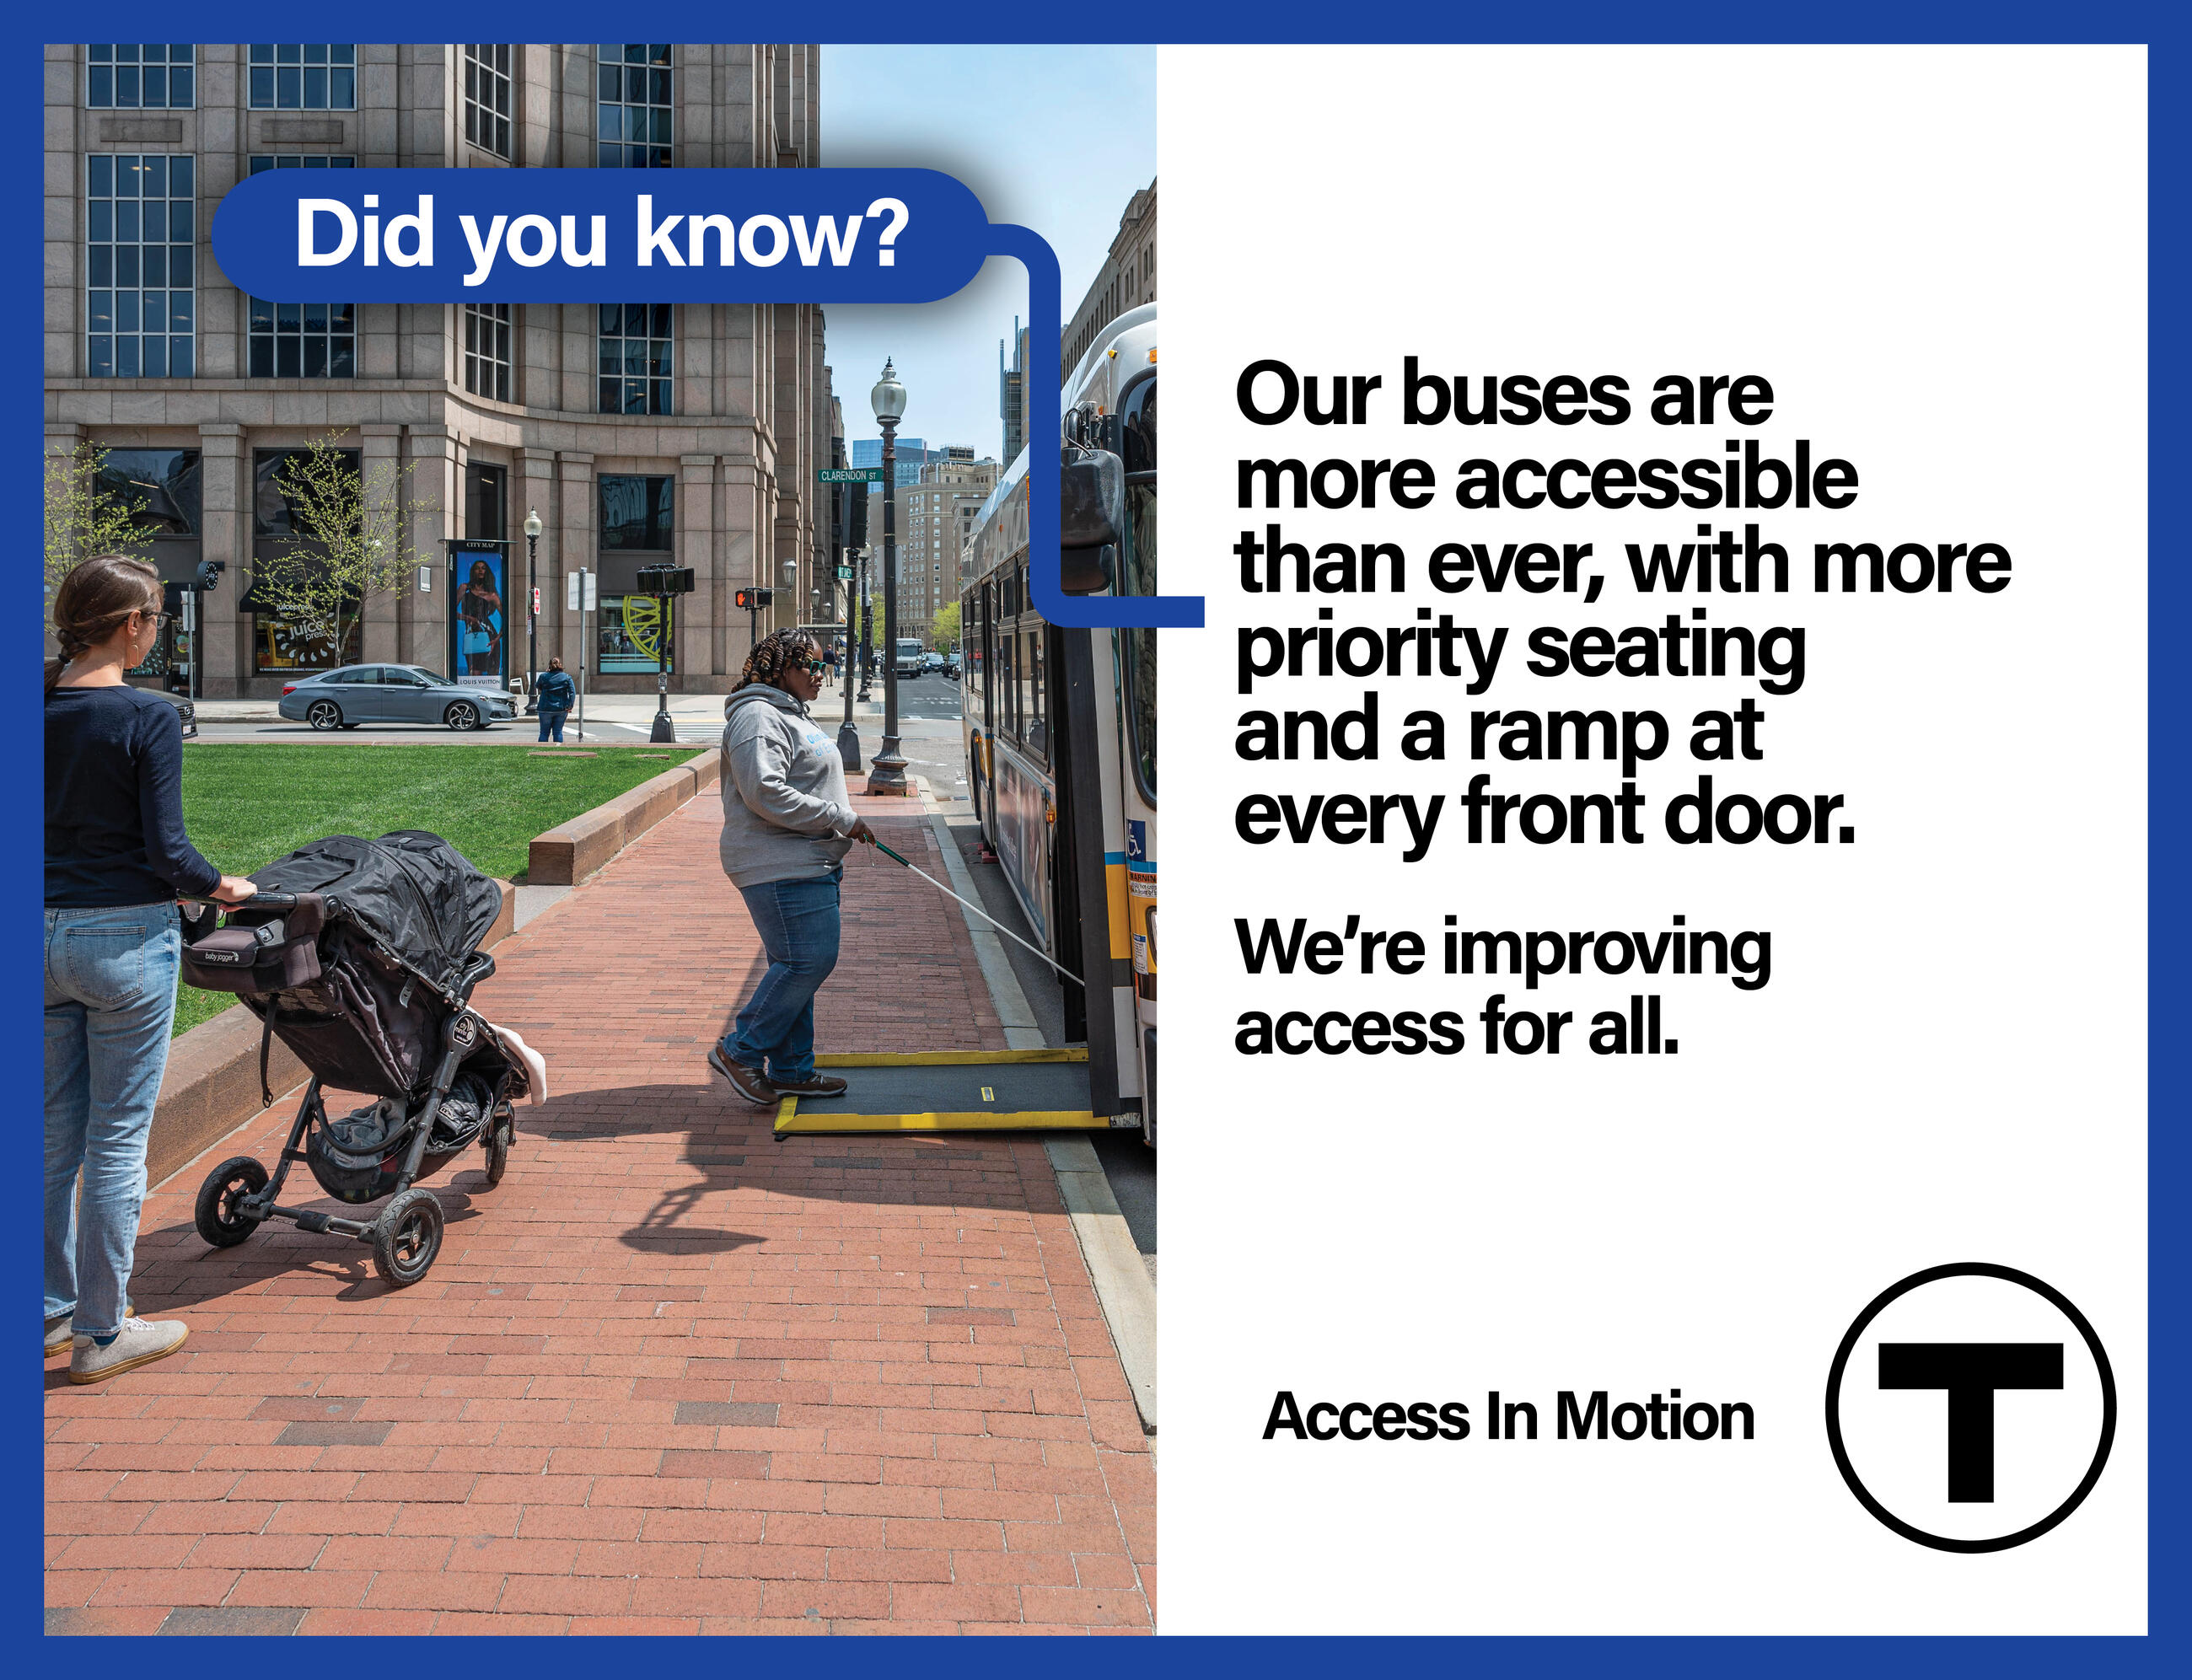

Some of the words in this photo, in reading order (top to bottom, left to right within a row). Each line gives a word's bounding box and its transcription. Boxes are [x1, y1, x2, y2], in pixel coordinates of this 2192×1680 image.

[821, 470, 867, 480] CLARENDON
[205, 952, 218, 961] baby
[217, 953, 234, 962] jogger
